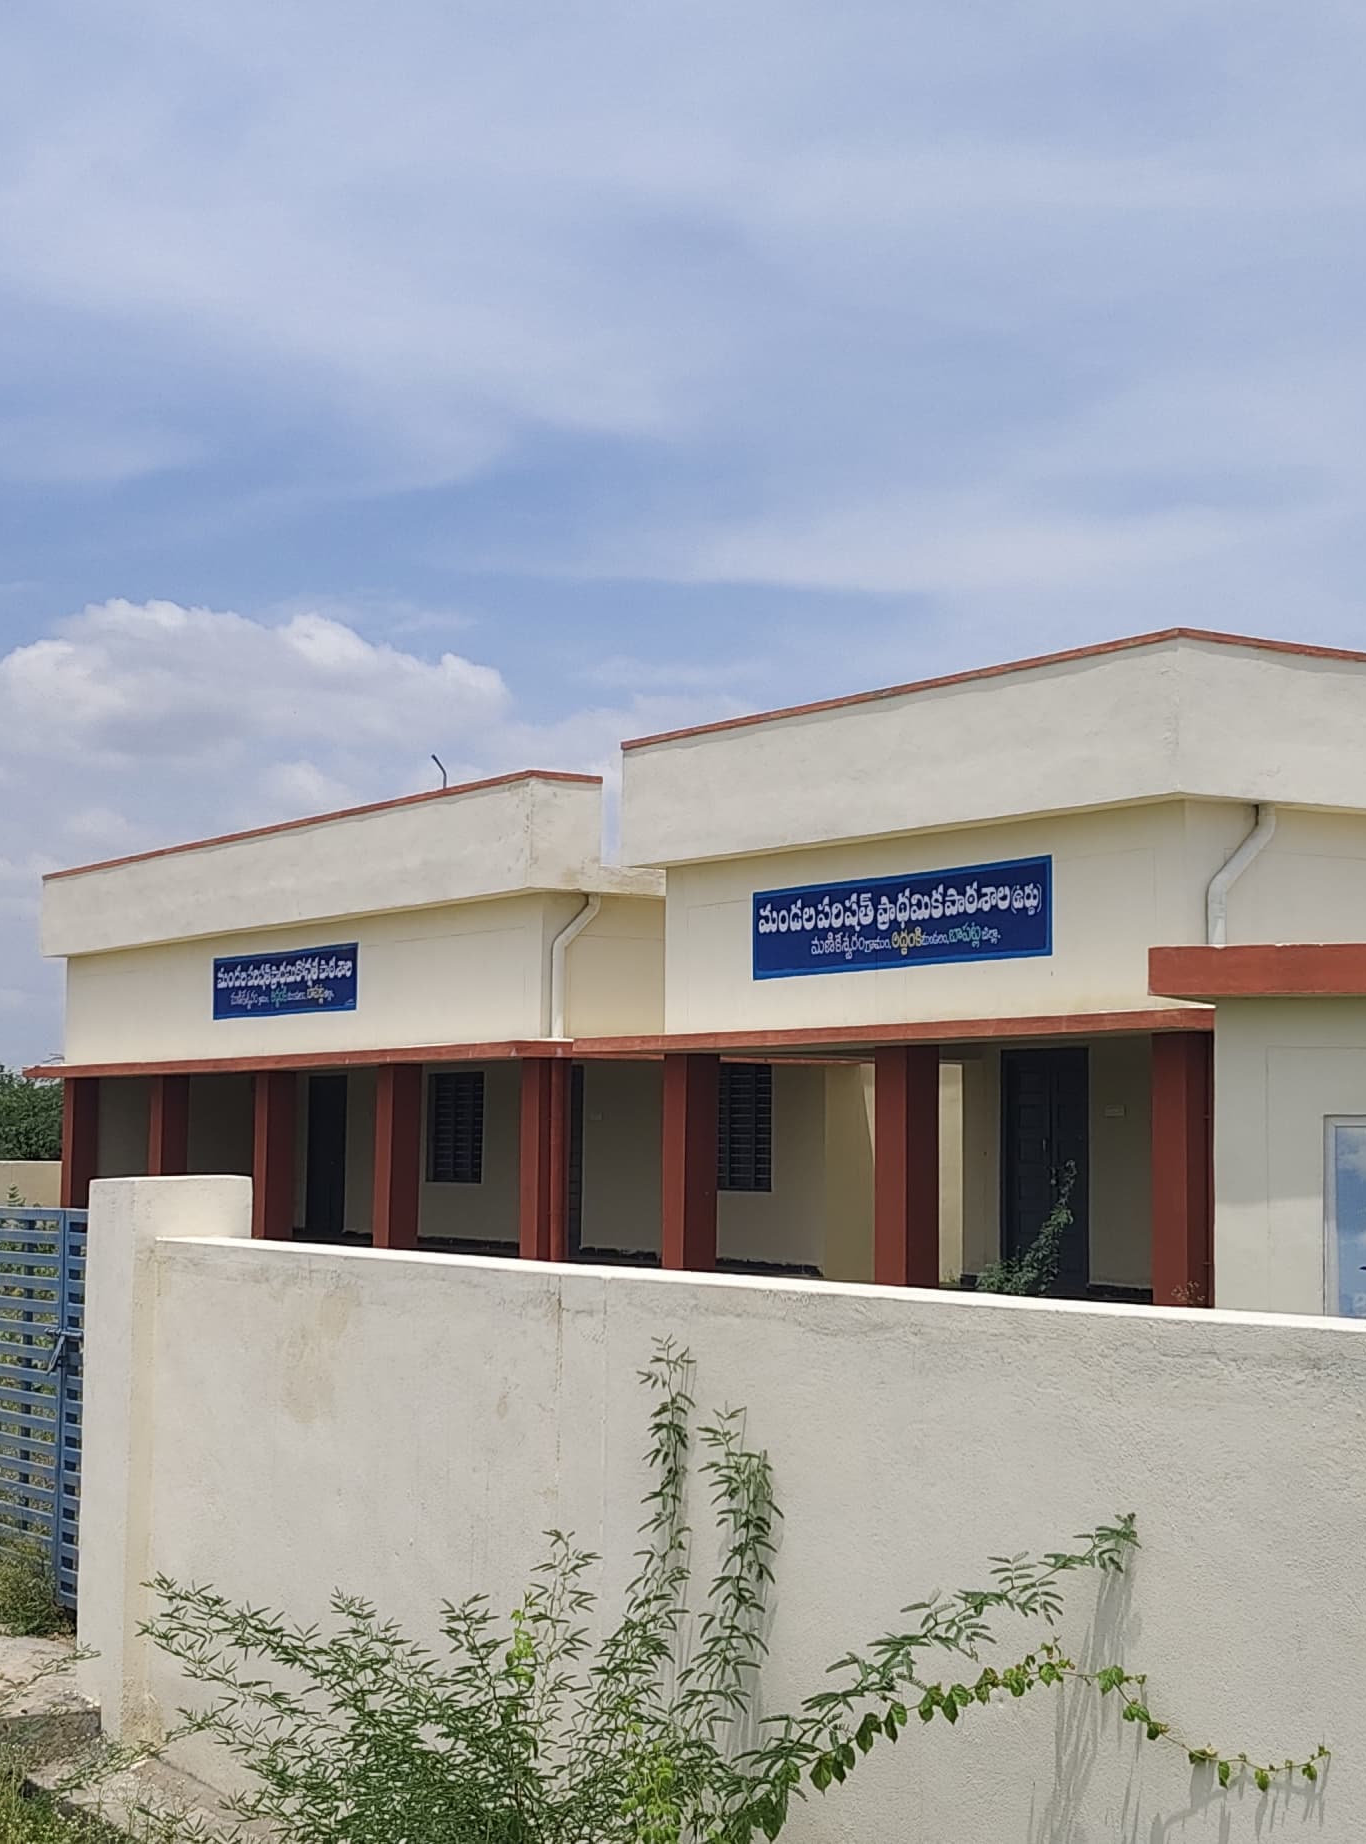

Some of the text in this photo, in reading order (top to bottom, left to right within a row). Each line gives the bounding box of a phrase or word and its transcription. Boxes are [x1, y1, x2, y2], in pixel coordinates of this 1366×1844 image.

[758, 898, 815, 934] మండల
[817, 892, 874, 932] పరిషత్
[944, 880, 1010, 917] పాఠశాల
